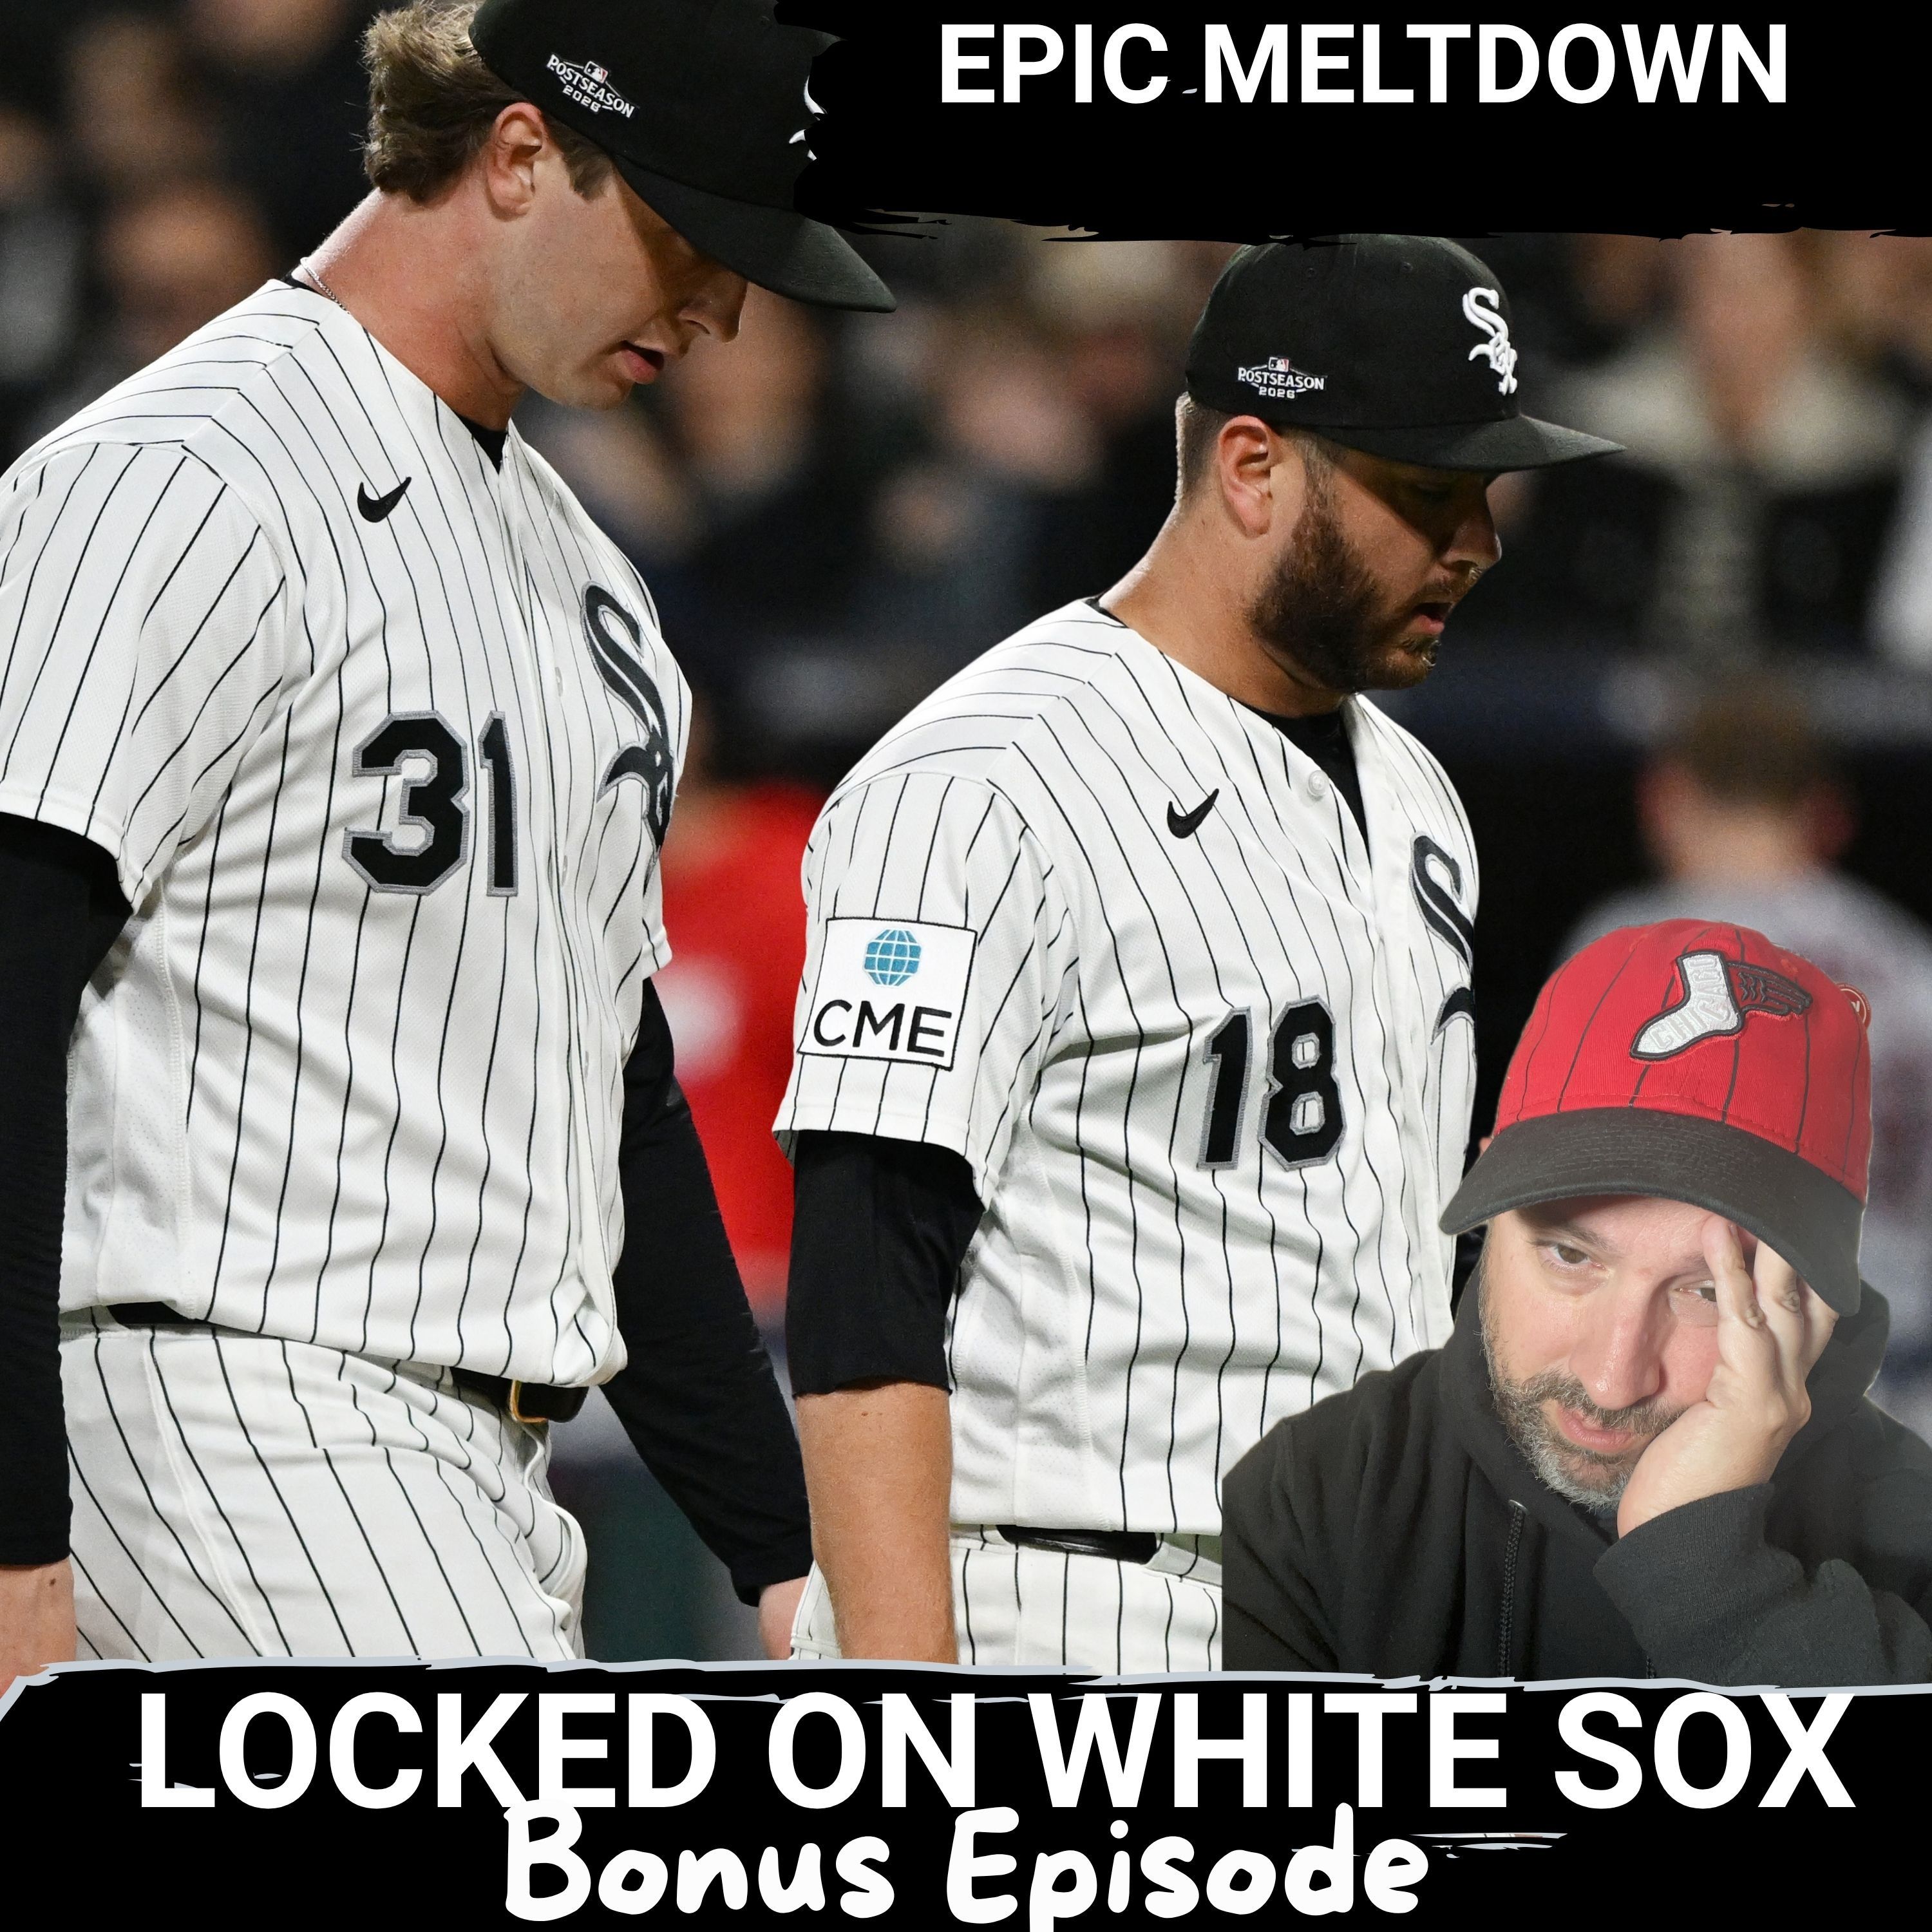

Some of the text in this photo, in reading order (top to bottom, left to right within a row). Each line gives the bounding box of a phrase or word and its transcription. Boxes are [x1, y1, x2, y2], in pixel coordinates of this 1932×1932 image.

[547, 54, 635, 118] POSTSEASON
[1238, 367, 1325, 390] POSTSEASON
[341, 709, 519, 898] 31
[813, 999, 952, 1057] CME
[1648, 956, 1731, 1050] CHICAGO
[1197, 994, 1346, 1171] 18
